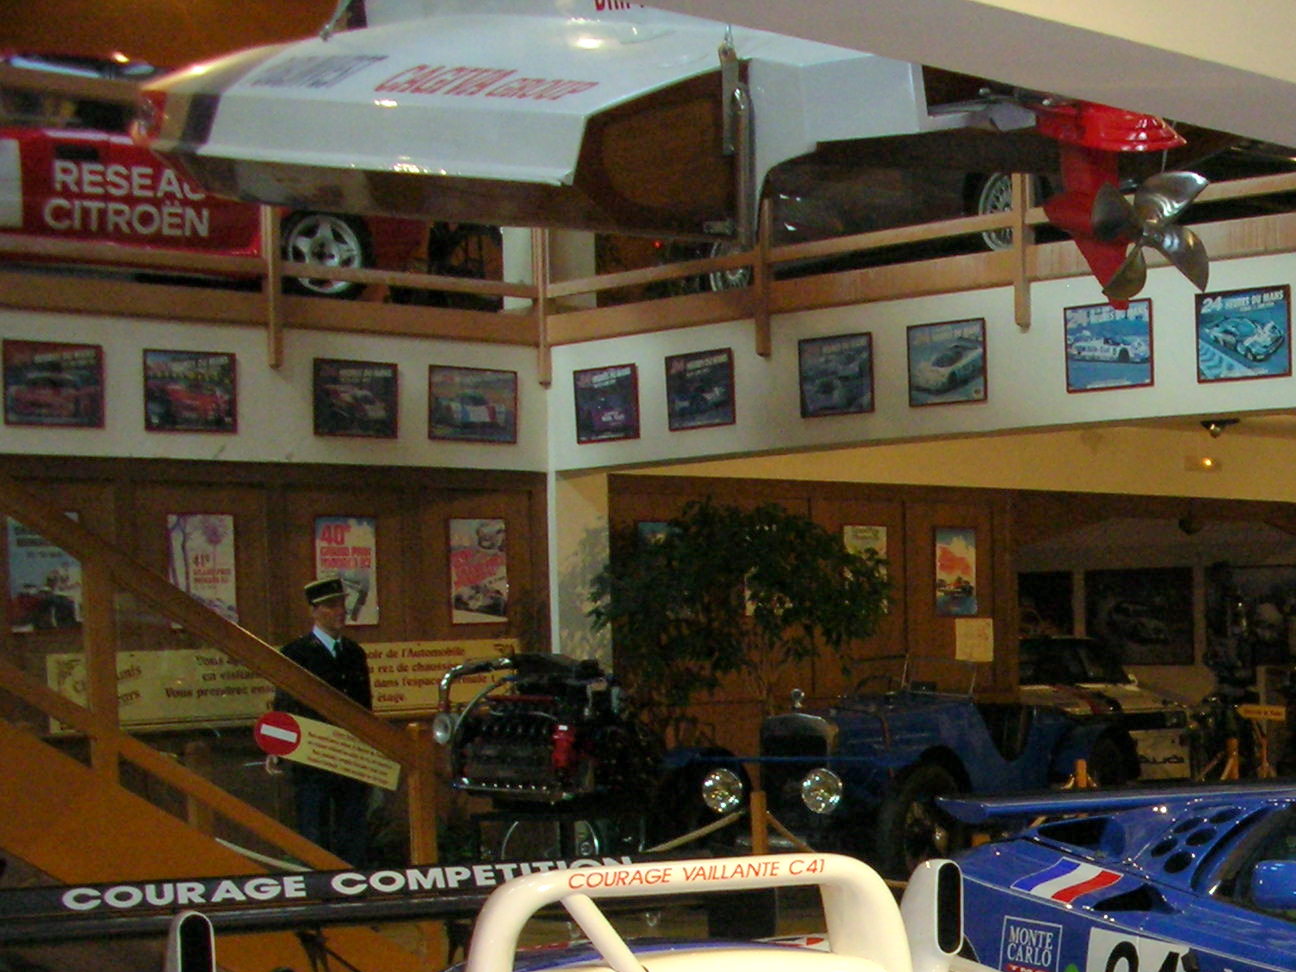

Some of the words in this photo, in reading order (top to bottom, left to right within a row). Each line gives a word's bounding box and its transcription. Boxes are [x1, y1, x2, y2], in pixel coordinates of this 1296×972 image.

[43, 197, 210, 237] CITROËN
[568, 868, 671, 890] COURAGE
[682, 861, 780, 882] VAILLANTE
[62, 876, 306, 911] COURAGE
[1008, 925, 1053, 950] MONTE
[1007, 943, 1052, 967] CARLO
